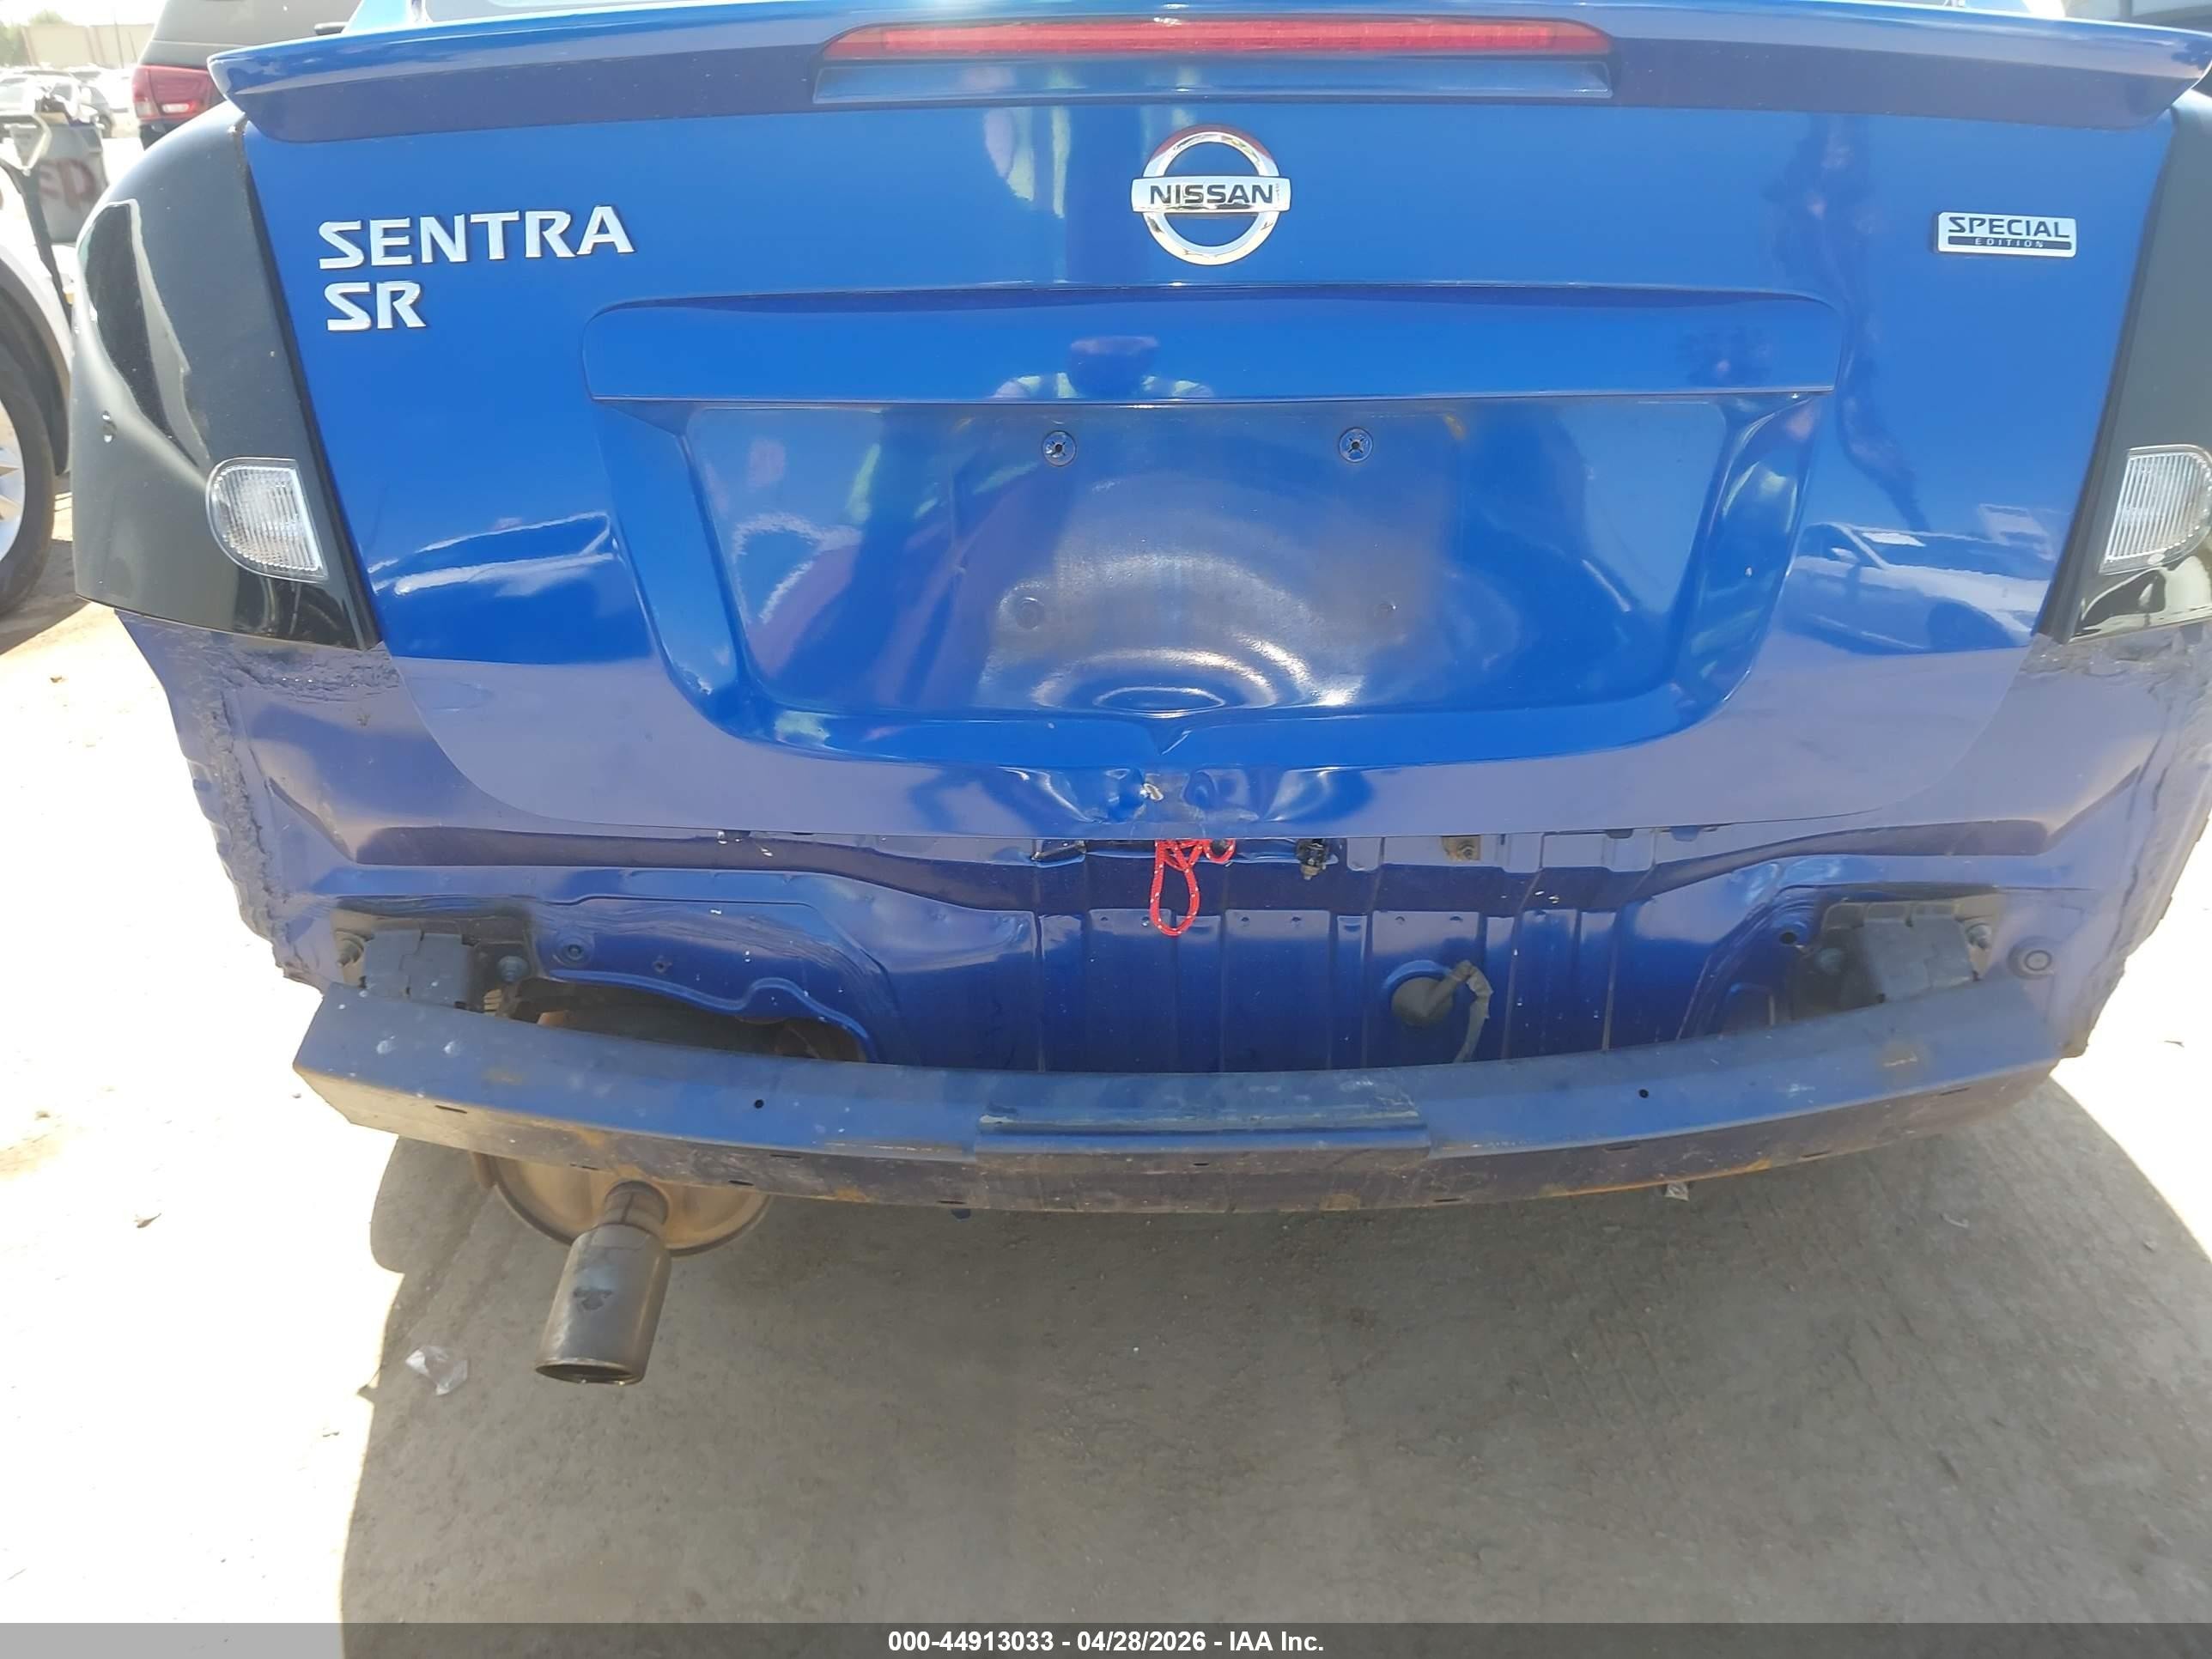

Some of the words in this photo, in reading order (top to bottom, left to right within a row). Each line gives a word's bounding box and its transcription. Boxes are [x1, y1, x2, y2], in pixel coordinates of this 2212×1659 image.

[1150, 184, 1273, 204] NISSAN
[318, 204, 636, 270] SENTRA
[1948, 216, 2070, 239] SPECIAL
[1974, 237, 2045, 249] EDITION
[323, 279, 427, 332] SR
